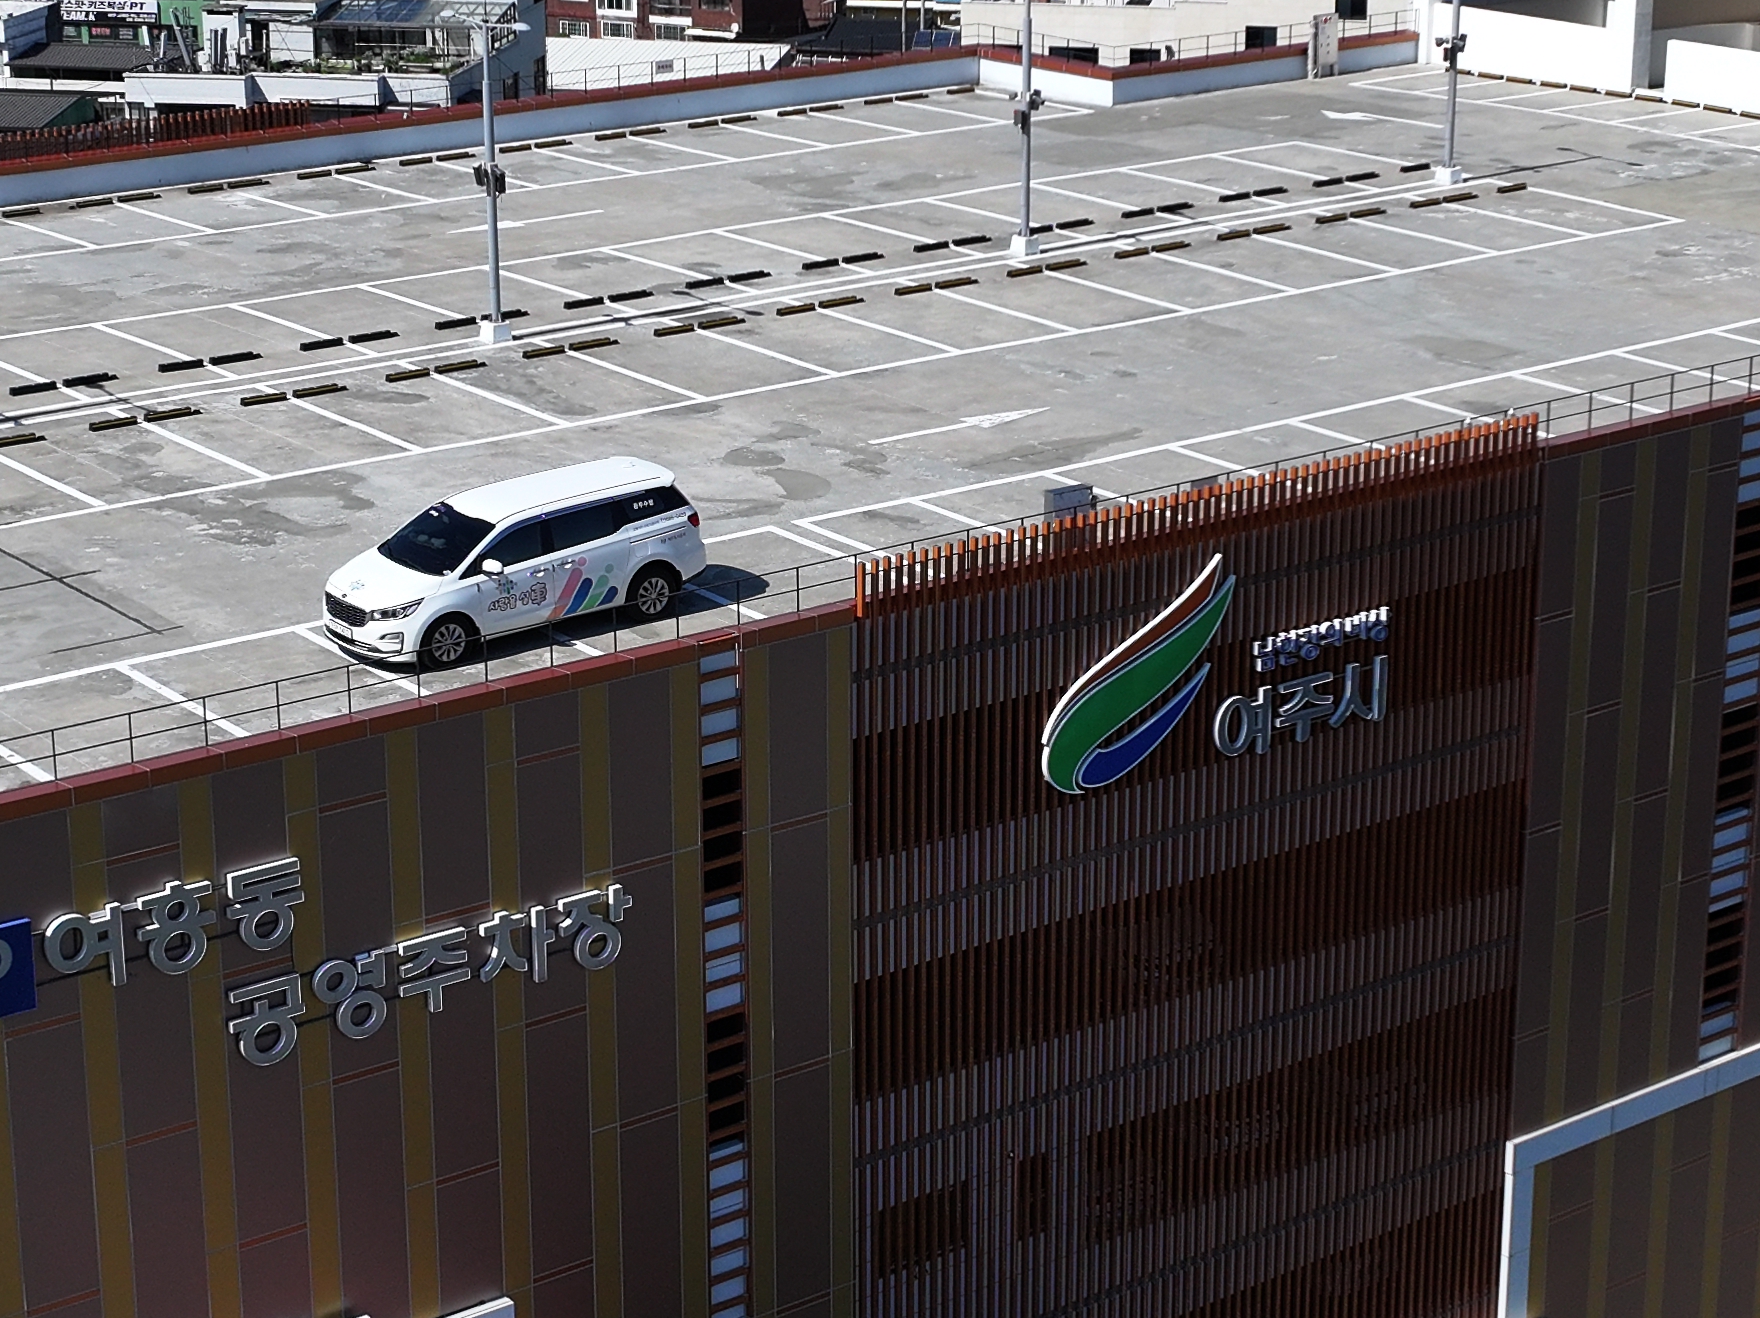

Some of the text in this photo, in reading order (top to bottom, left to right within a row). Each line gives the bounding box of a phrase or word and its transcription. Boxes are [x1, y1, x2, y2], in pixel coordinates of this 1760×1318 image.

[488, 593, 517, 612] 사랑을
[1252, 618, 1344, 672] 남한강의
[1213, 654, 1389, 757] 여주시
[43, 856, 306, 986] 여흥동
[227, 883, 634, 1067] 공영주차장
